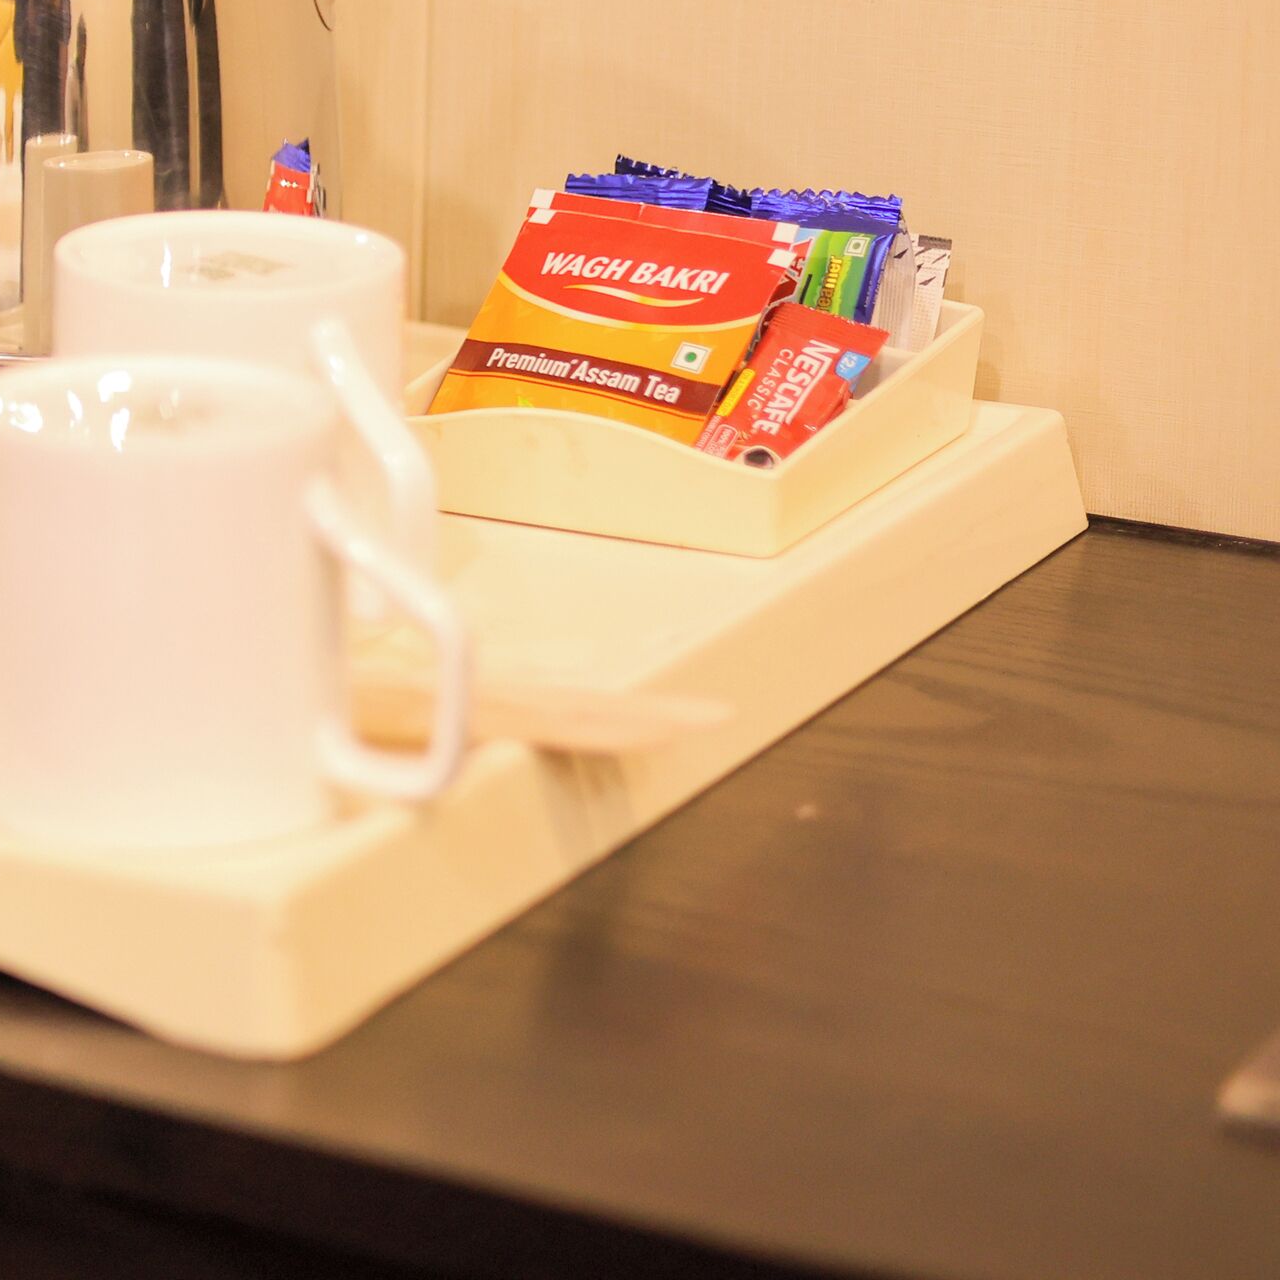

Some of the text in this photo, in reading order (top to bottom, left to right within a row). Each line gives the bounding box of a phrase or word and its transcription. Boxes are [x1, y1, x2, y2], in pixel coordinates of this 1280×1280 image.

[540, 251, 730, 295] WAGH BAKRI
[486, 347, 572, 378] Premium
[570, 360, 641, 394] Assam
[644, 374, 682, 404] Tea
[747, 347, 794, 411] CLASSIC
